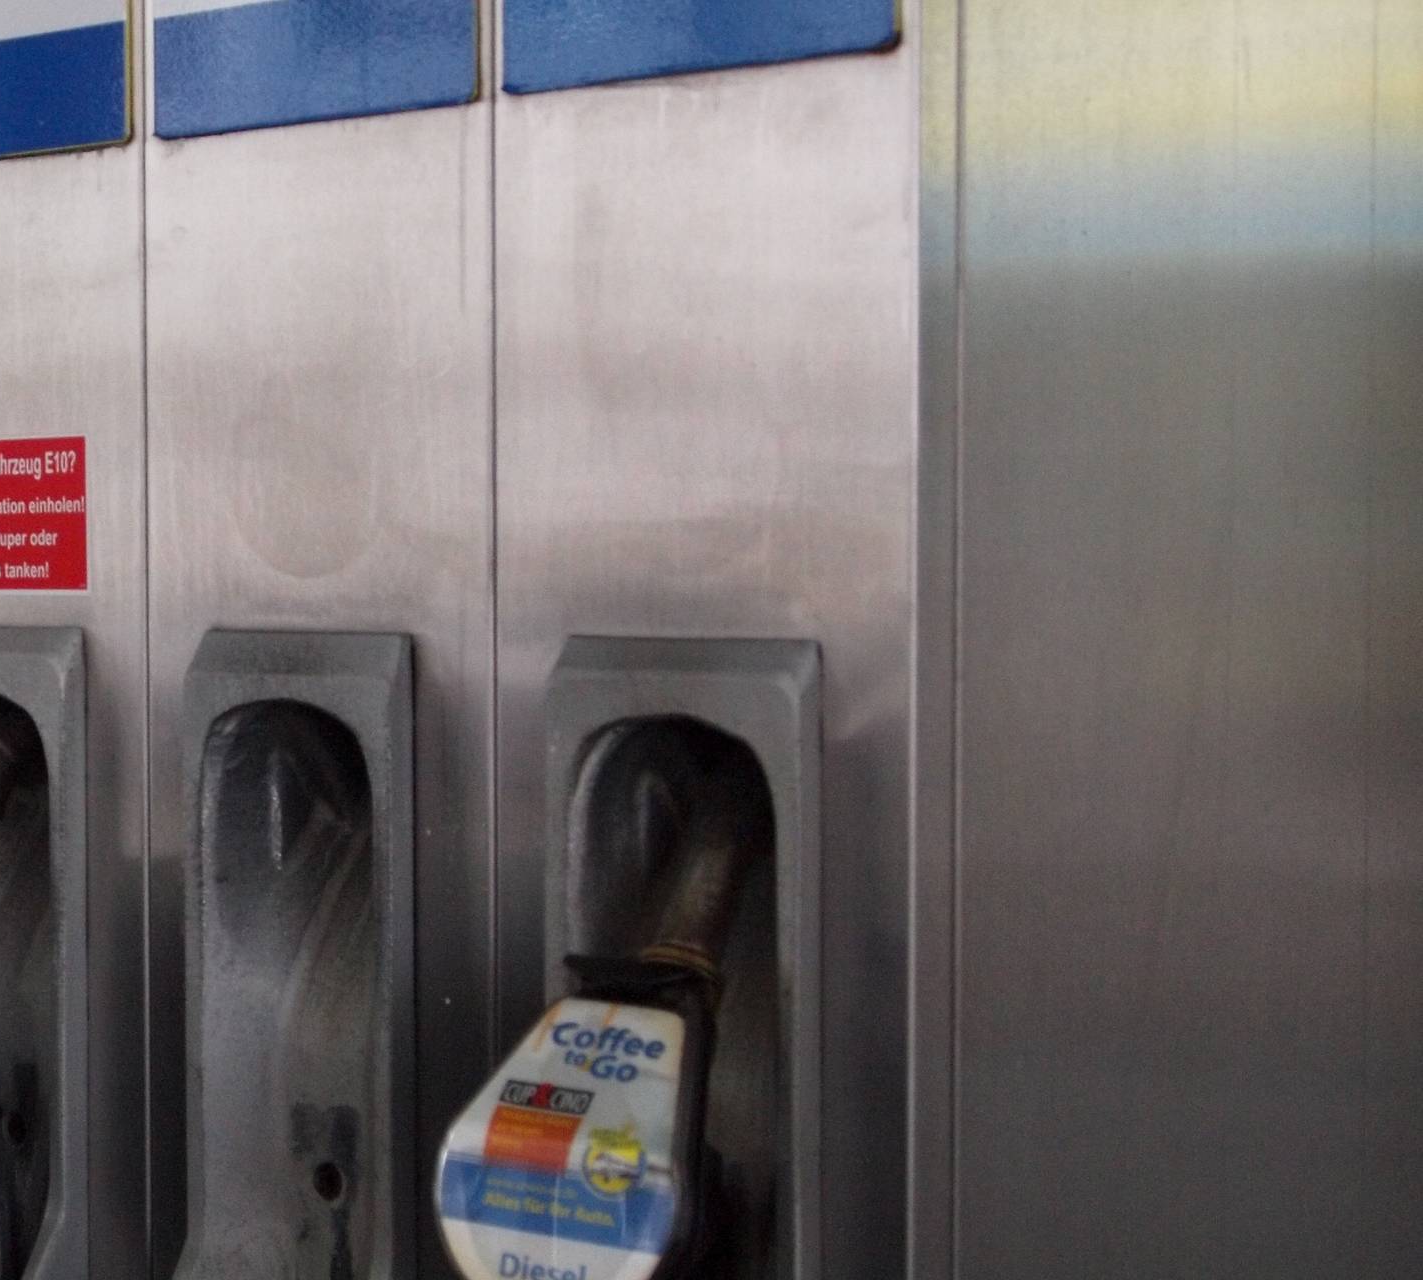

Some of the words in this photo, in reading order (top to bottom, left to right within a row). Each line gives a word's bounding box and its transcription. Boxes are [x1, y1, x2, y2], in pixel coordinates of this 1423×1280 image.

[45, 450, 77, 475] E10?
[29, 496, 85, 514] einholen!
[29, 529, 57, 546] oder
[5, 562, 49, 578] tanken!
[552, 1021, 665, 1060] Coffee
[565, 1050, 586, 1068] to
[590, 1055, 639, 1084] Go
[499, 1252, 587, 1280] Diesel
